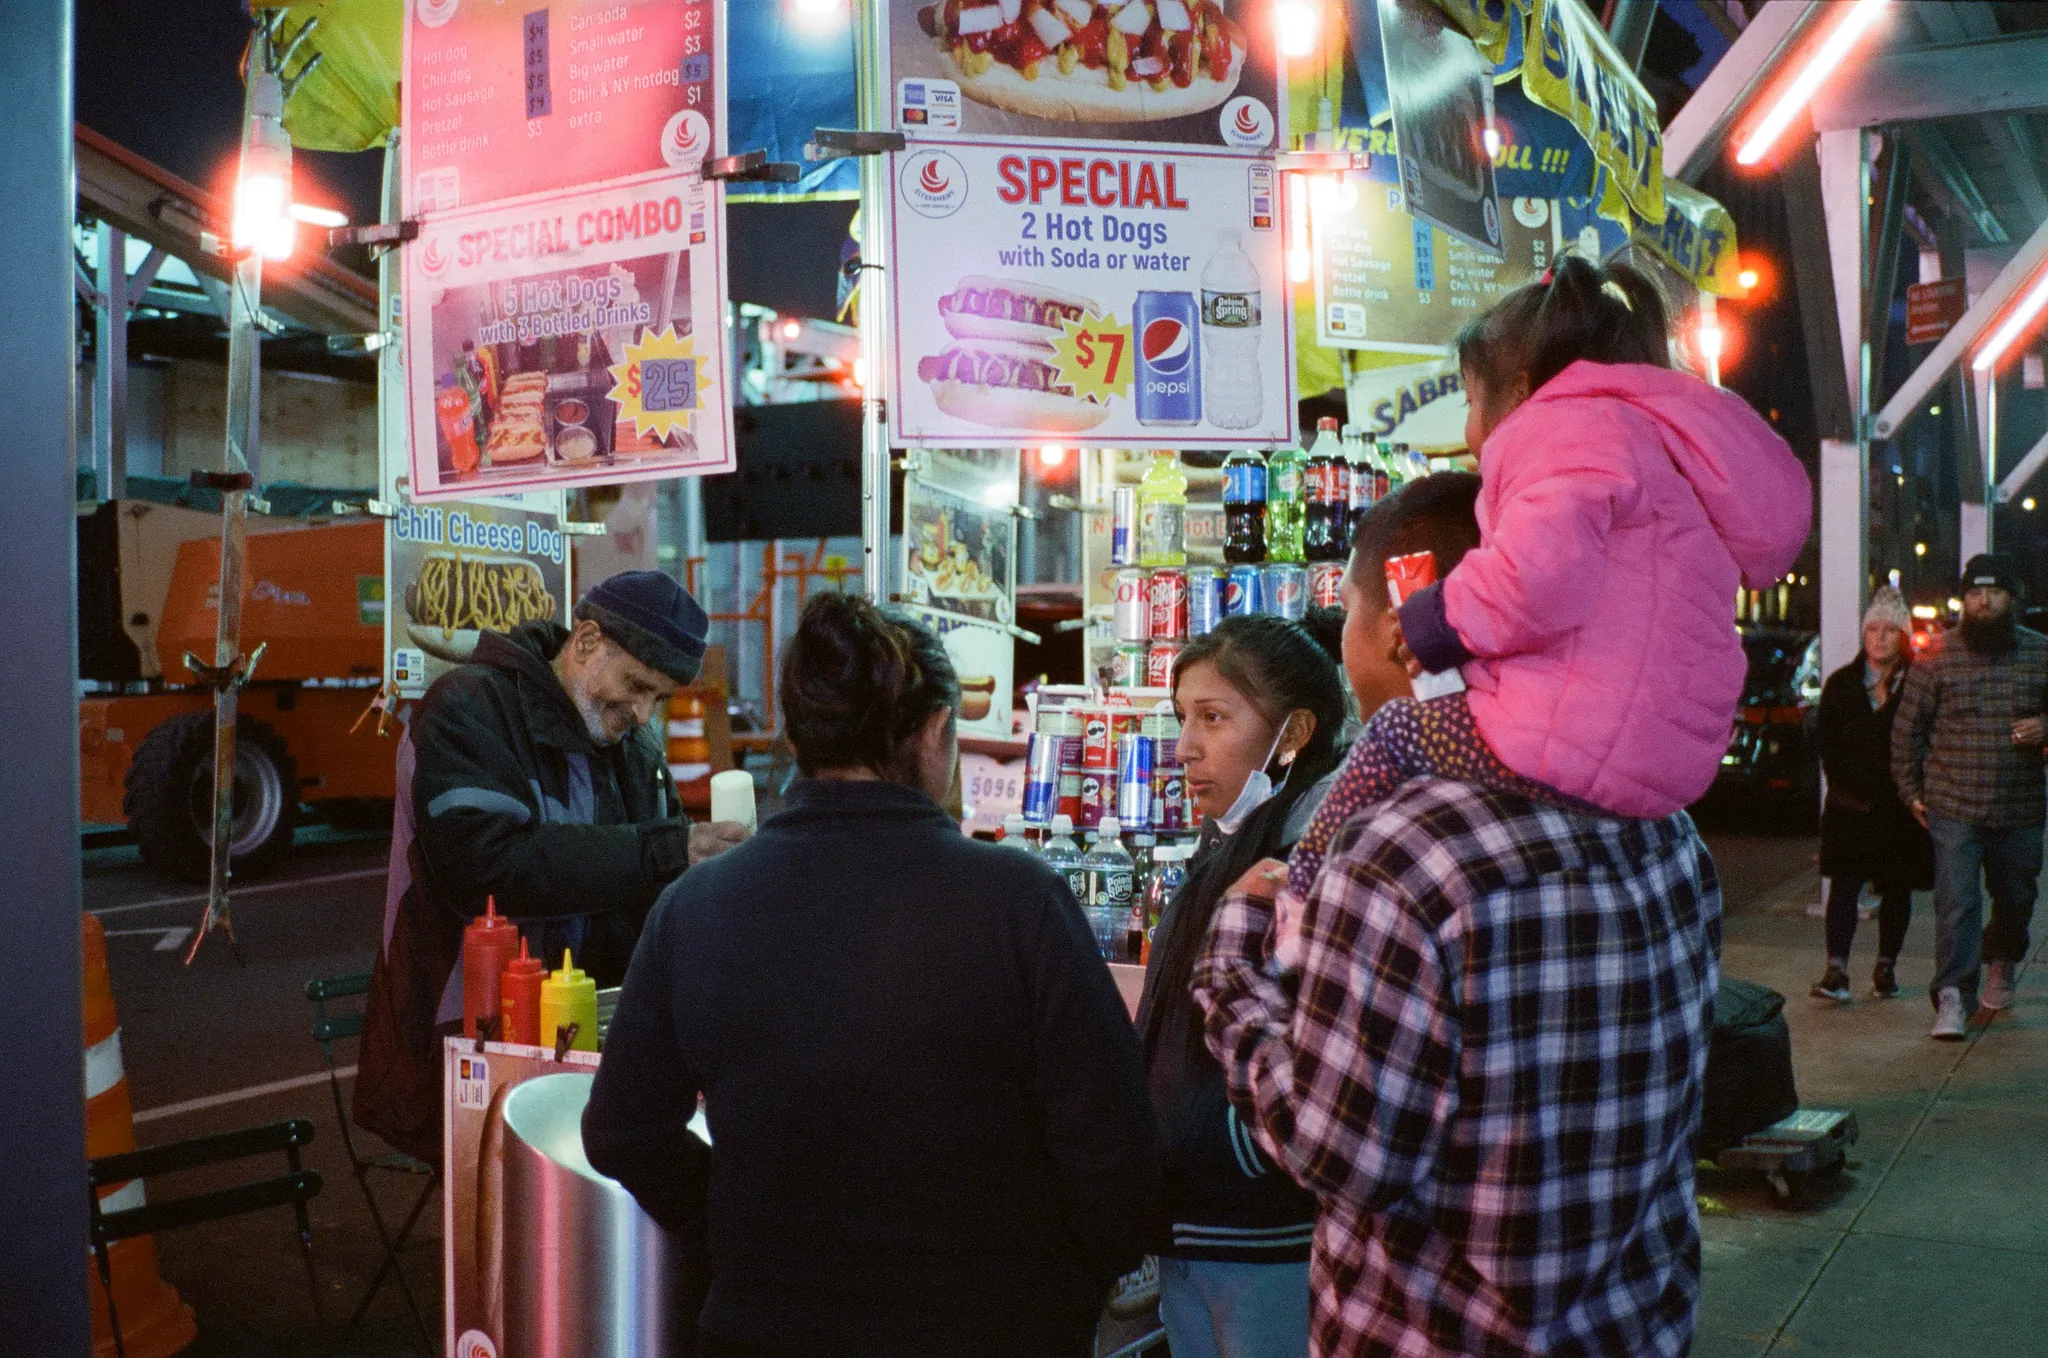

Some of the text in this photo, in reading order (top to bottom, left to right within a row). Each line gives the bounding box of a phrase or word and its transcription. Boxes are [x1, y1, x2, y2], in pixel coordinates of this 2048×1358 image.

[570, 5, 627, 31] Can soda
[685, 10, 700, 30] $2
[570, 26, 645, 56] Small water
[685, 35, 700, 54] $3
[423, 46, 467, 65] Hot dog
[570, 55, 630, 80] Big water
[422, 68, 471, 91] Chili dog
[570, 68, 679, 104] Chili & NY hotdog
[422, 86, 494, 112] Hot Sausage
[687, 85, 701, 105] $1
[935, 95, 954, 103] VISA
[422, 116, 462, 136] Pretzel
[527, 120, 542, 138] $3
[570, 110, 601, 128] extra
[422, 133, 490, 160] Bottle drink
[996, 154, 1190, 211] SPECIAL
[457, 196, 682, 269] SPECIAL COMBO
[1021, 212, 1168, 249] 2 Hot Dogs
[998, 245, 1191, 272] with Soda or water
[505, 276, 622, 316] 5 Hot Dogs
[1218, 297, 1244, 306] Poland
[479, 301, 649, 345] with 3 Bottled Drinks
[1215, 305, 1247, 320] Spring
[1075, 329, 1126, 384] $7
[1146, 378, 1191, 397] pepsi
[395, 507, 563, 563] Chili Cheese Dog
[971, 776, 1016, 799] 5096
